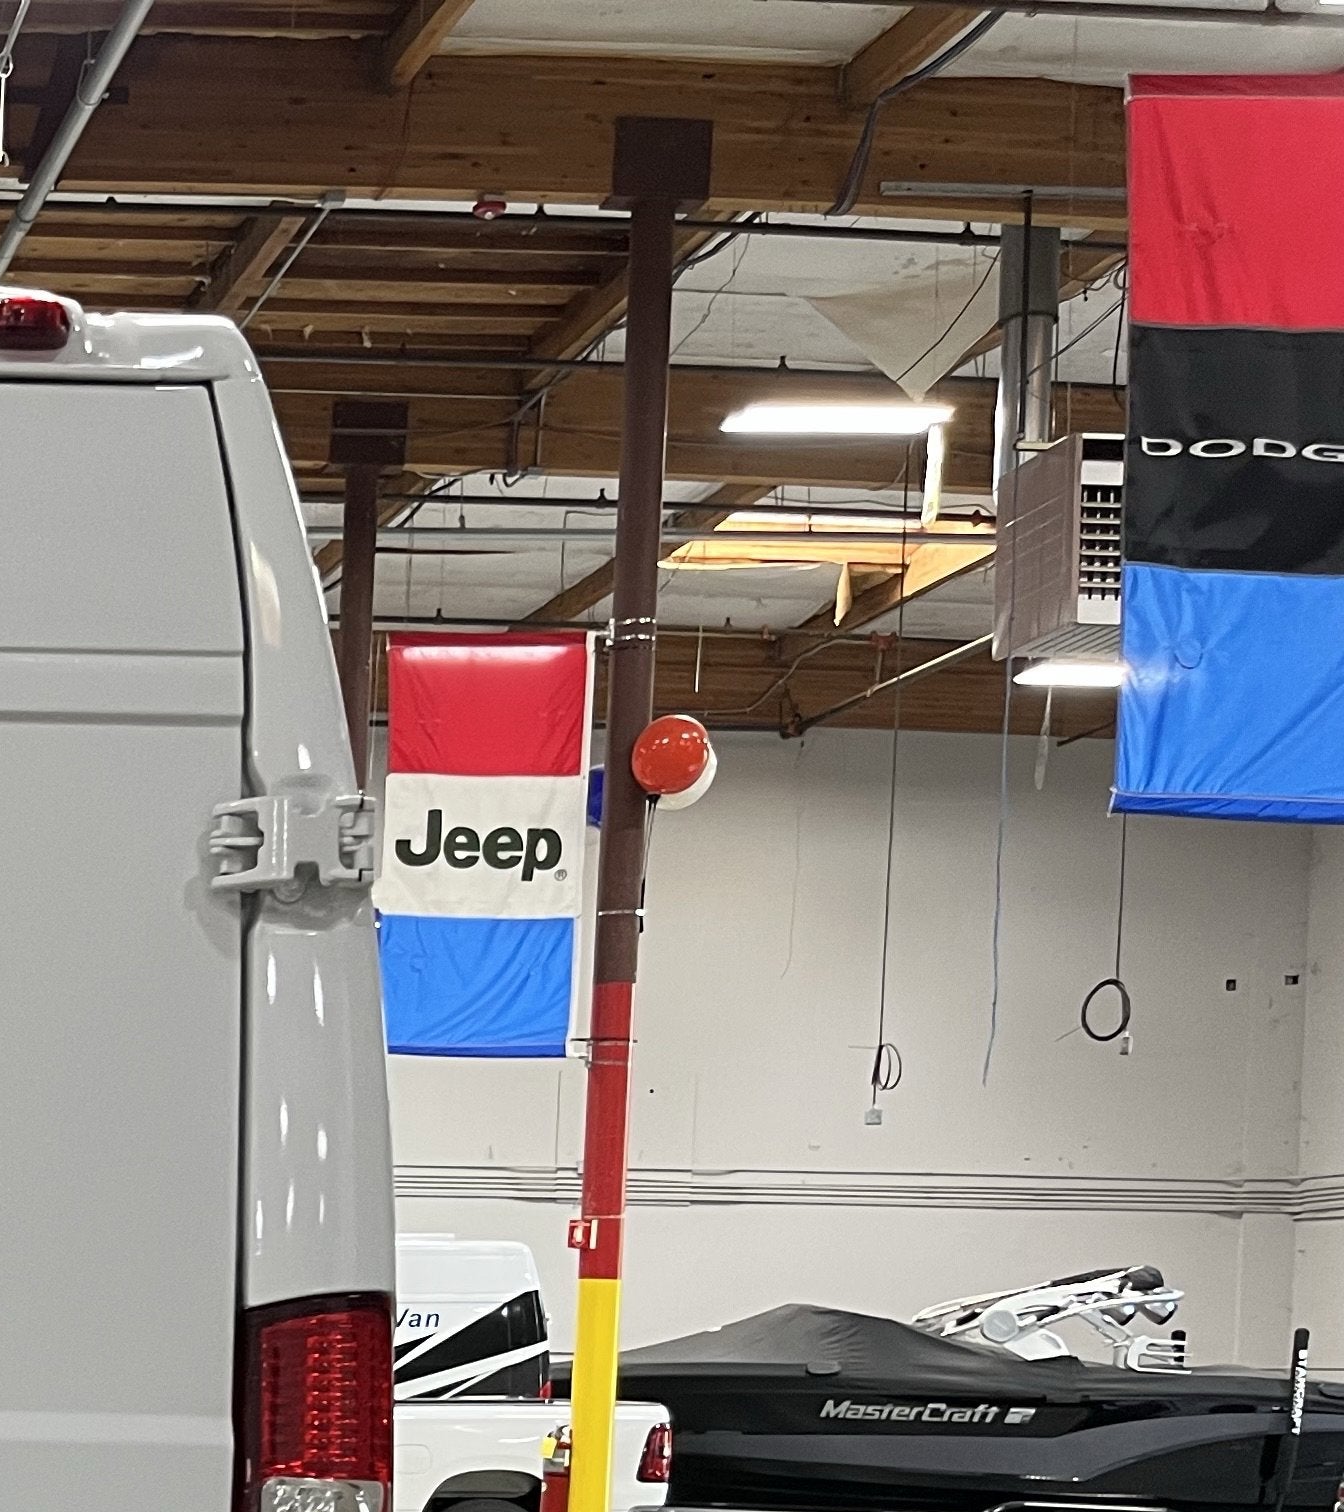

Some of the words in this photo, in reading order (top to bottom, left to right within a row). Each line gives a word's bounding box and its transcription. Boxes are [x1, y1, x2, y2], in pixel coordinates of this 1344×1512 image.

[1141, 436, 1344, 462] DODG
[395, 809, 562, 882] Jeep
[819, 1400, 1000, 1423] MasterCraft
